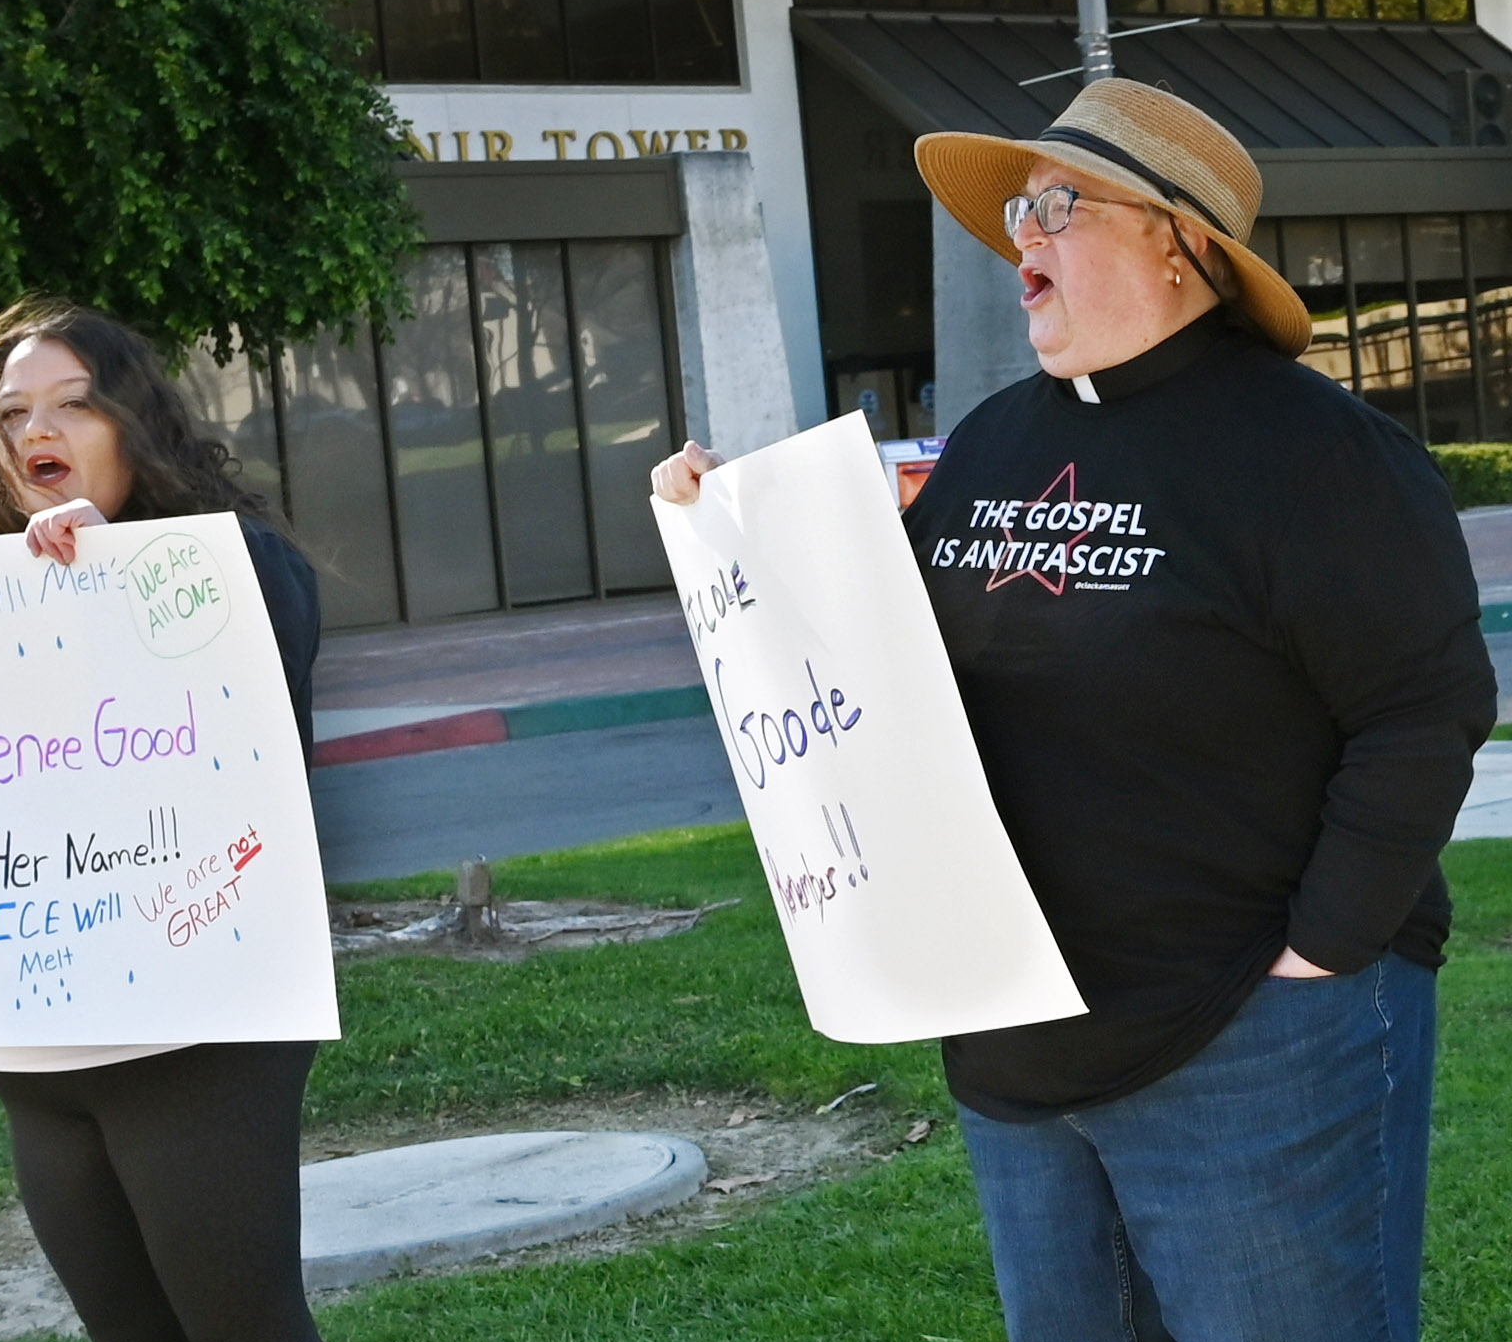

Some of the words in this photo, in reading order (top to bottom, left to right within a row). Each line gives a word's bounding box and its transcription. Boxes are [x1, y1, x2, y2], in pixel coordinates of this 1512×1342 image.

[969, 499, 1025, 529] THE
[1025, 500, 1148, 536] GOSPEL
[130, 560, 168, 602] We
[169, 541, 201, 576] Are
[931, 537, 956, 568] IS
[957, 540, 1166, 577] ANTIFASCIST
[174, 576, 223, 620] ONE
[93, 690, 197, 768] Good
[715, 657, 863, 790] Goode
[65, 806, 182, 880] Name!!!
[133, 881, 178, 924] We
[187, 852, 219, 886] are
[226, 823, 261, 865] not
[71, 891, 122, 931] Will
[167, 875, 242, 948] GREAT
[18, 946, 74, 983] Melt
